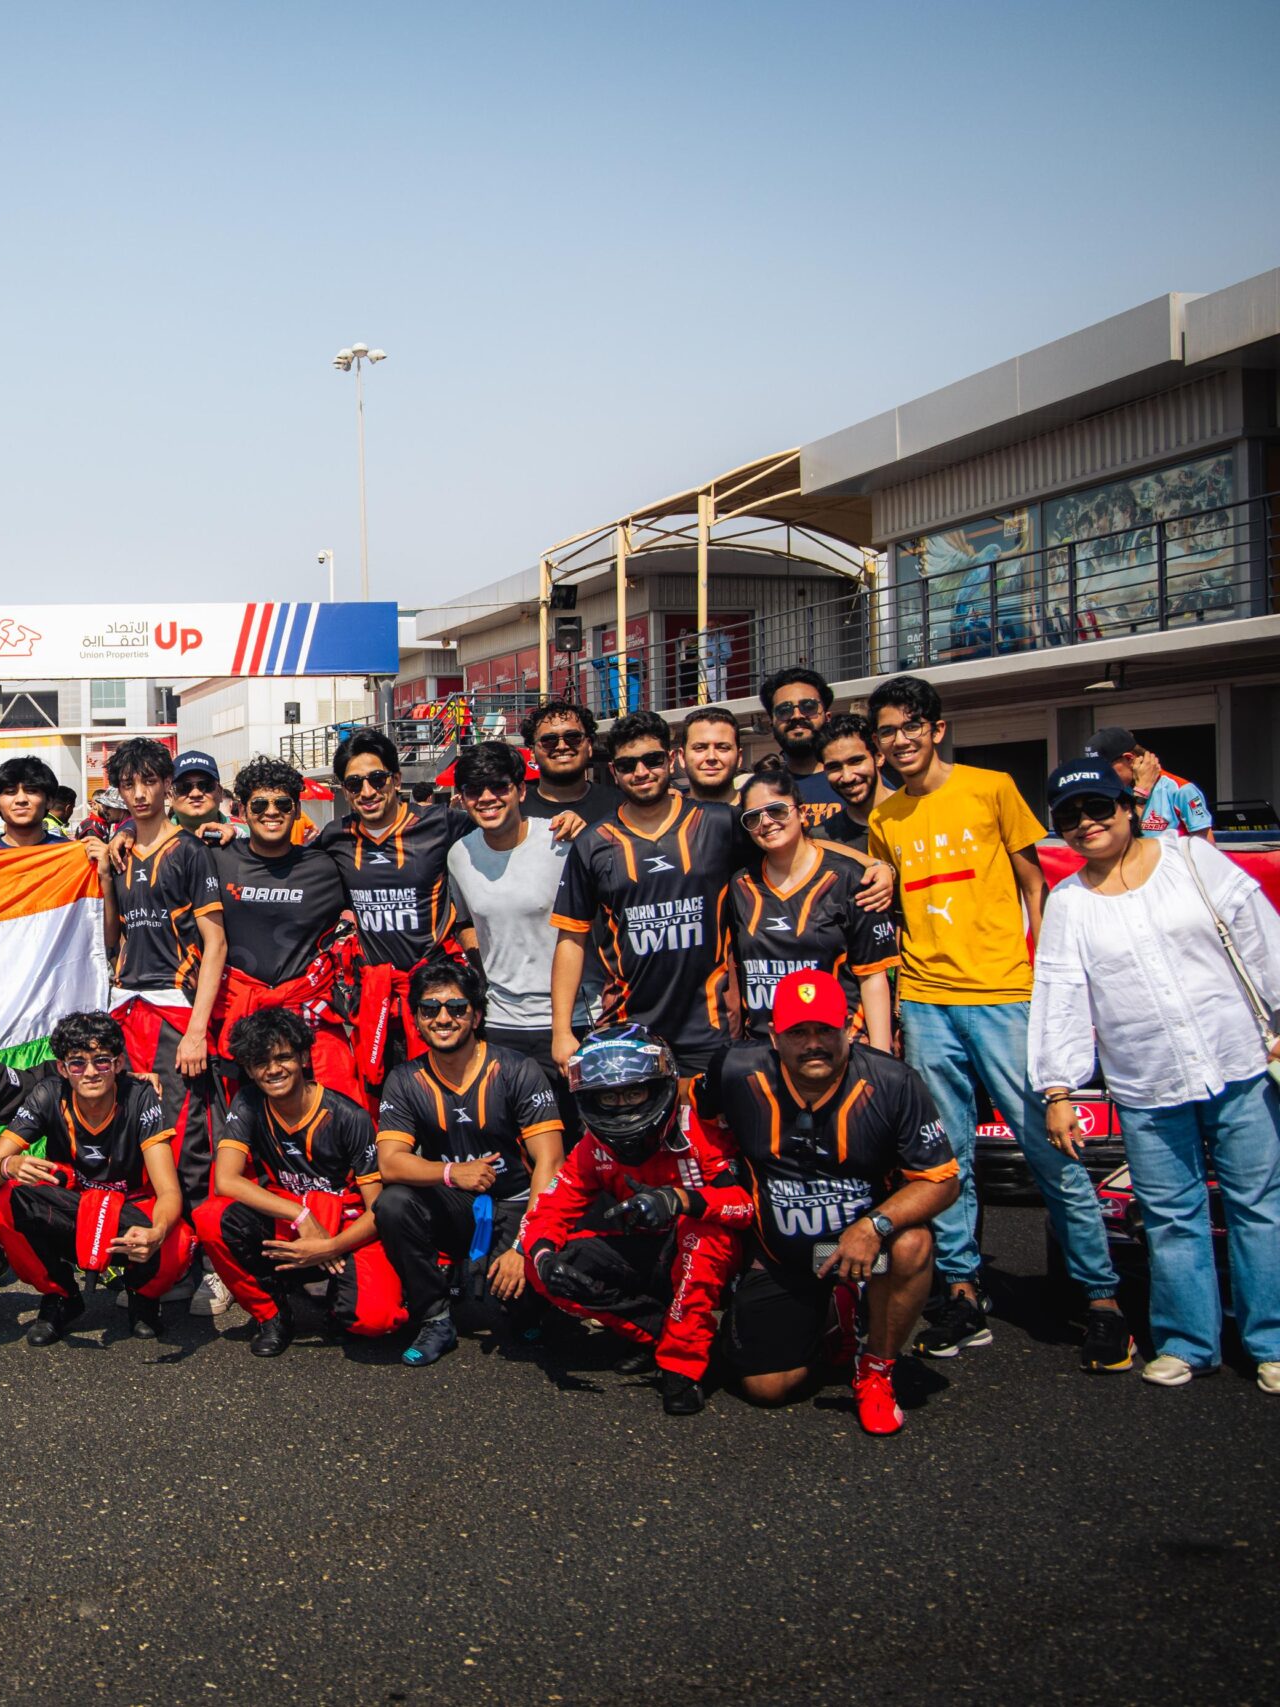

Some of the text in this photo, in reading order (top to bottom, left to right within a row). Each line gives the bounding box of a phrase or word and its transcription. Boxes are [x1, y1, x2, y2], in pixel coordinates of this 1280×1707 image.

[79, 650, 150, 659] Union Properties
[179, 757, 209, 767] Aayan
[1058, 771, 1100, 787] Aayan
[241, 886, 304, 901] DAMC
[373, 889, 388, 902] TO
[389, 887, 417, 901] RACE
[625, 896, 704, 921] BORN TO RACE
[770, 960, 786, 975] TO
[374, 1006, 388, 1044] KARTDROME
[807, 1180, 829, 1195] TO
[91, 1207, 108, 1257] KARTDROME
